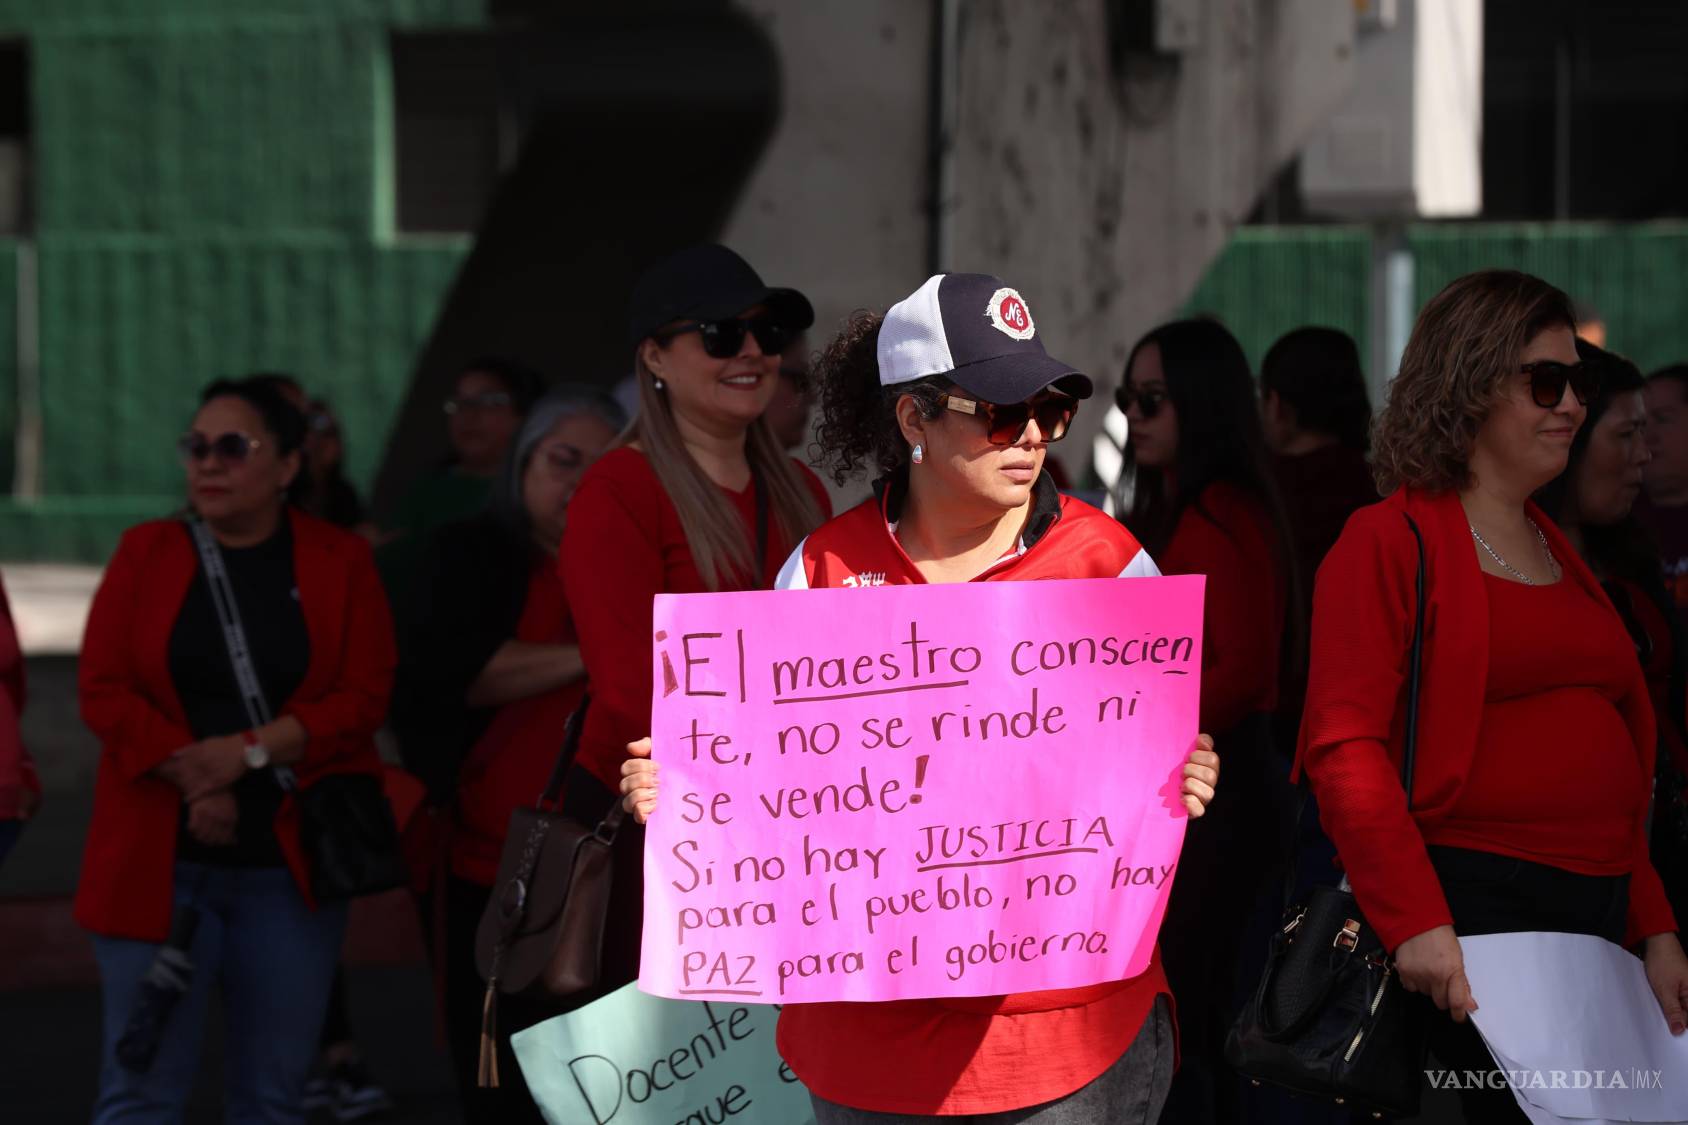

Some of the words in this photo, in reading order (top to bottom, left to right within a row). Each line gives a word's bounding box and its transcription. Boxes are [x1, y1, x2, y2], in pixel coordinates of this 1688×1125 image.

[654, 628, 746, 703] ¡El
[772, 621, 982, 697] maestro
[680, 718, 752, 766] te,
[778, 722, 840, 755] no
[861, 716, 912, 749] se
[932, 687, 1066, 741] rinde
[1098, 690, 1141, 722] ni
[681, 792, 733, 825] se
[759, 754, 930, 819] vende!
[734, 856, 785, 883] no
[804, 834, 887, 879] hay
[915, 816, 1114, 865] JUSTICIA
[678, 901, 776, 945] para
[802, 883, 839, 926] el
[866, 873, 1010, 934] pueblo,
[1026, 873, 1077, 900] no
[1111, 856, 1175, 890] hay
[682, 951, 757, 990] PAZ
[777, 951, 864, 996] para
[887, 935, 918, 975] el
[945, 929, 1109, 981] gobierno.
[567, 1001, 755, 1125] Docente
